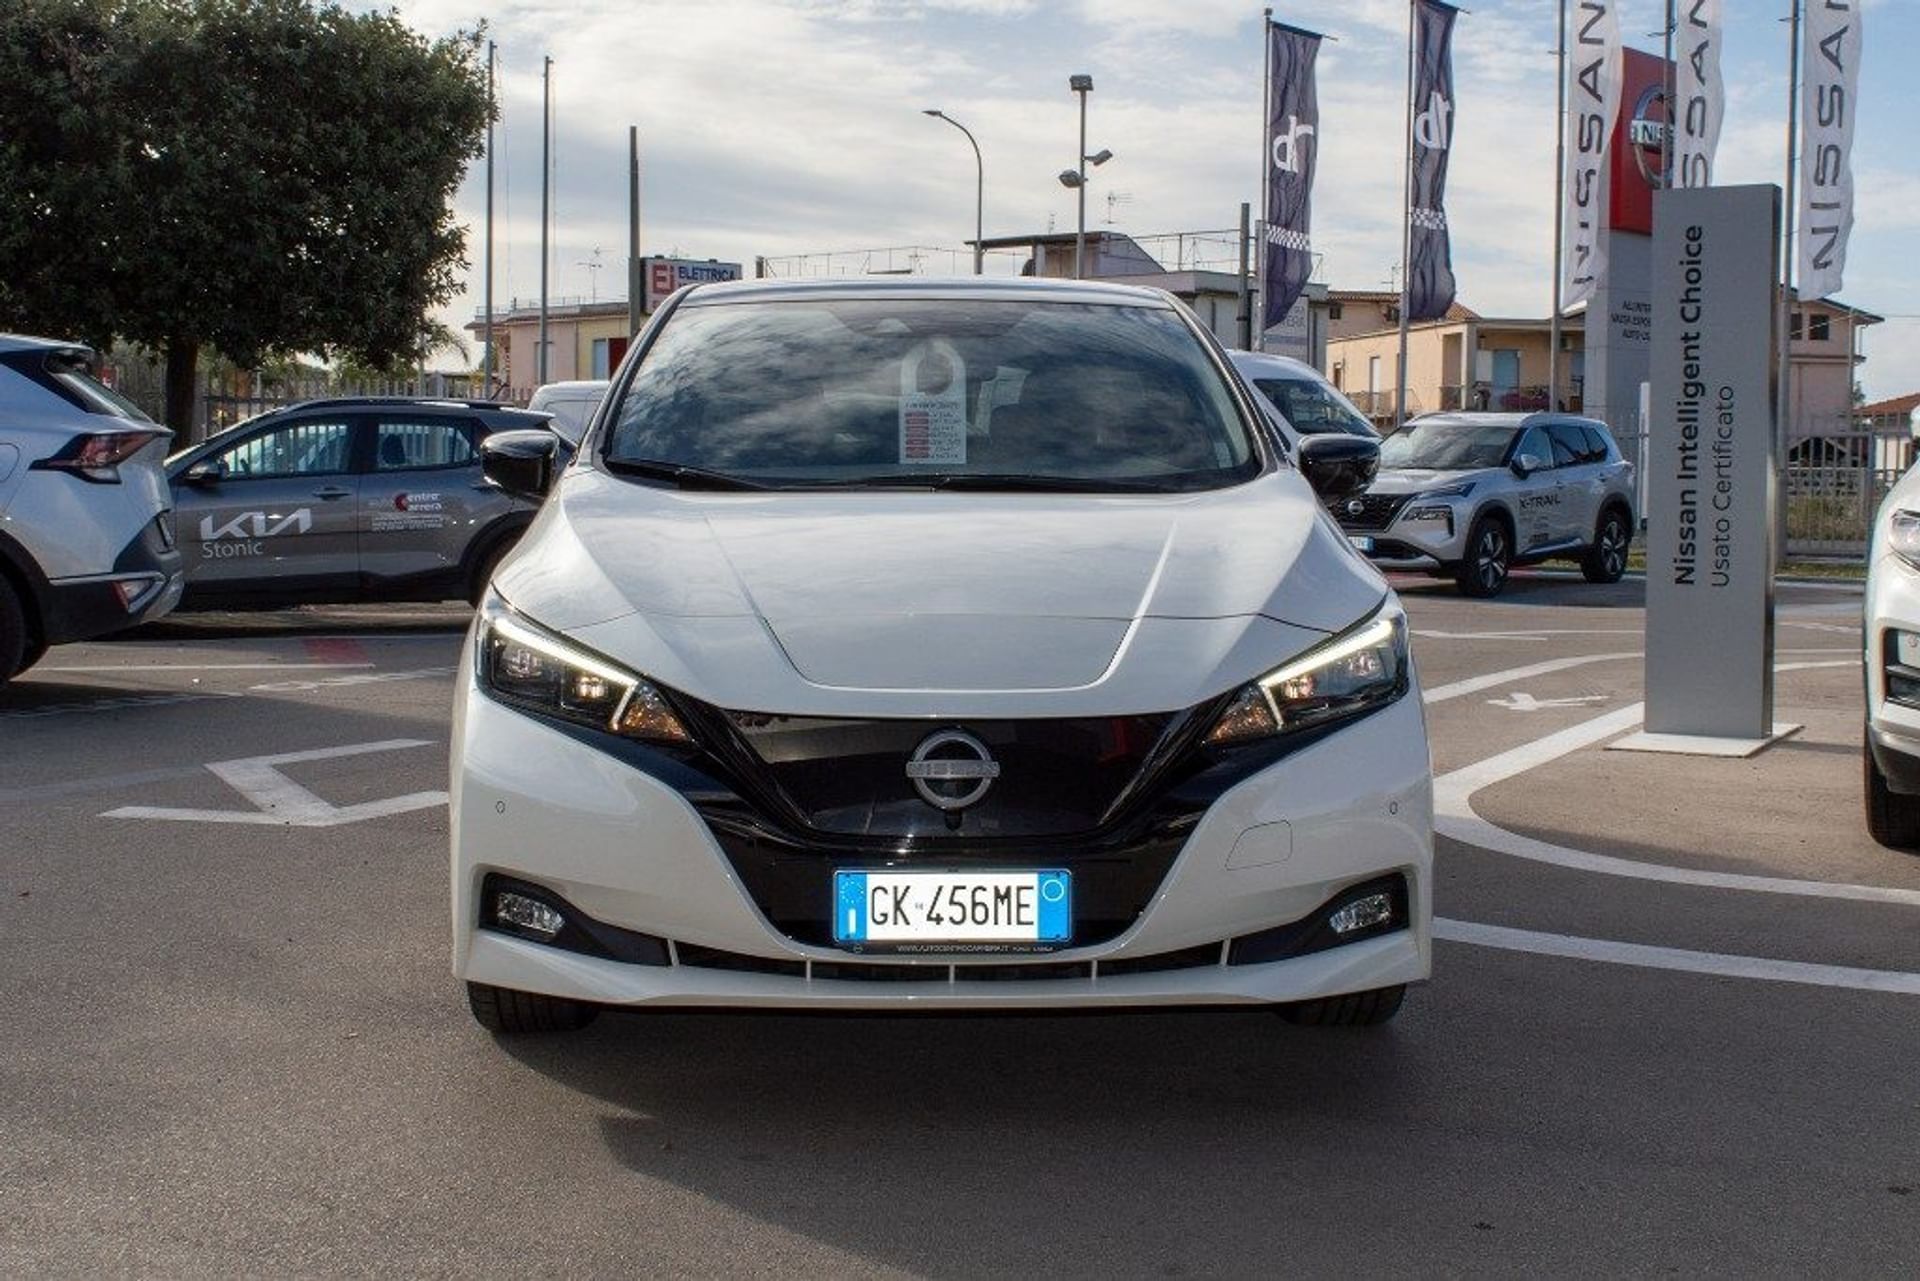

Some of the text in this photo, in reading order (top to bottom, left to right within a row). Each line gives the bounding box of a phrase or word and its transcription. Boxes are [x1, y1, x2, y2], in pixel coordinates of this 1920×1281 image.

[1810, 0, 1850, 270] NISSA
[1675, 225, 1706, 585] Nissan Intelligent Choice
[201, 508, 312, 540] KIA
[1711, 385, 1735, 588] Usato Certificato
[202, 540, 263, 559] Stonic
[870, 885, 911, 926] GK
[926, 885, 1035, 926] 456ME
